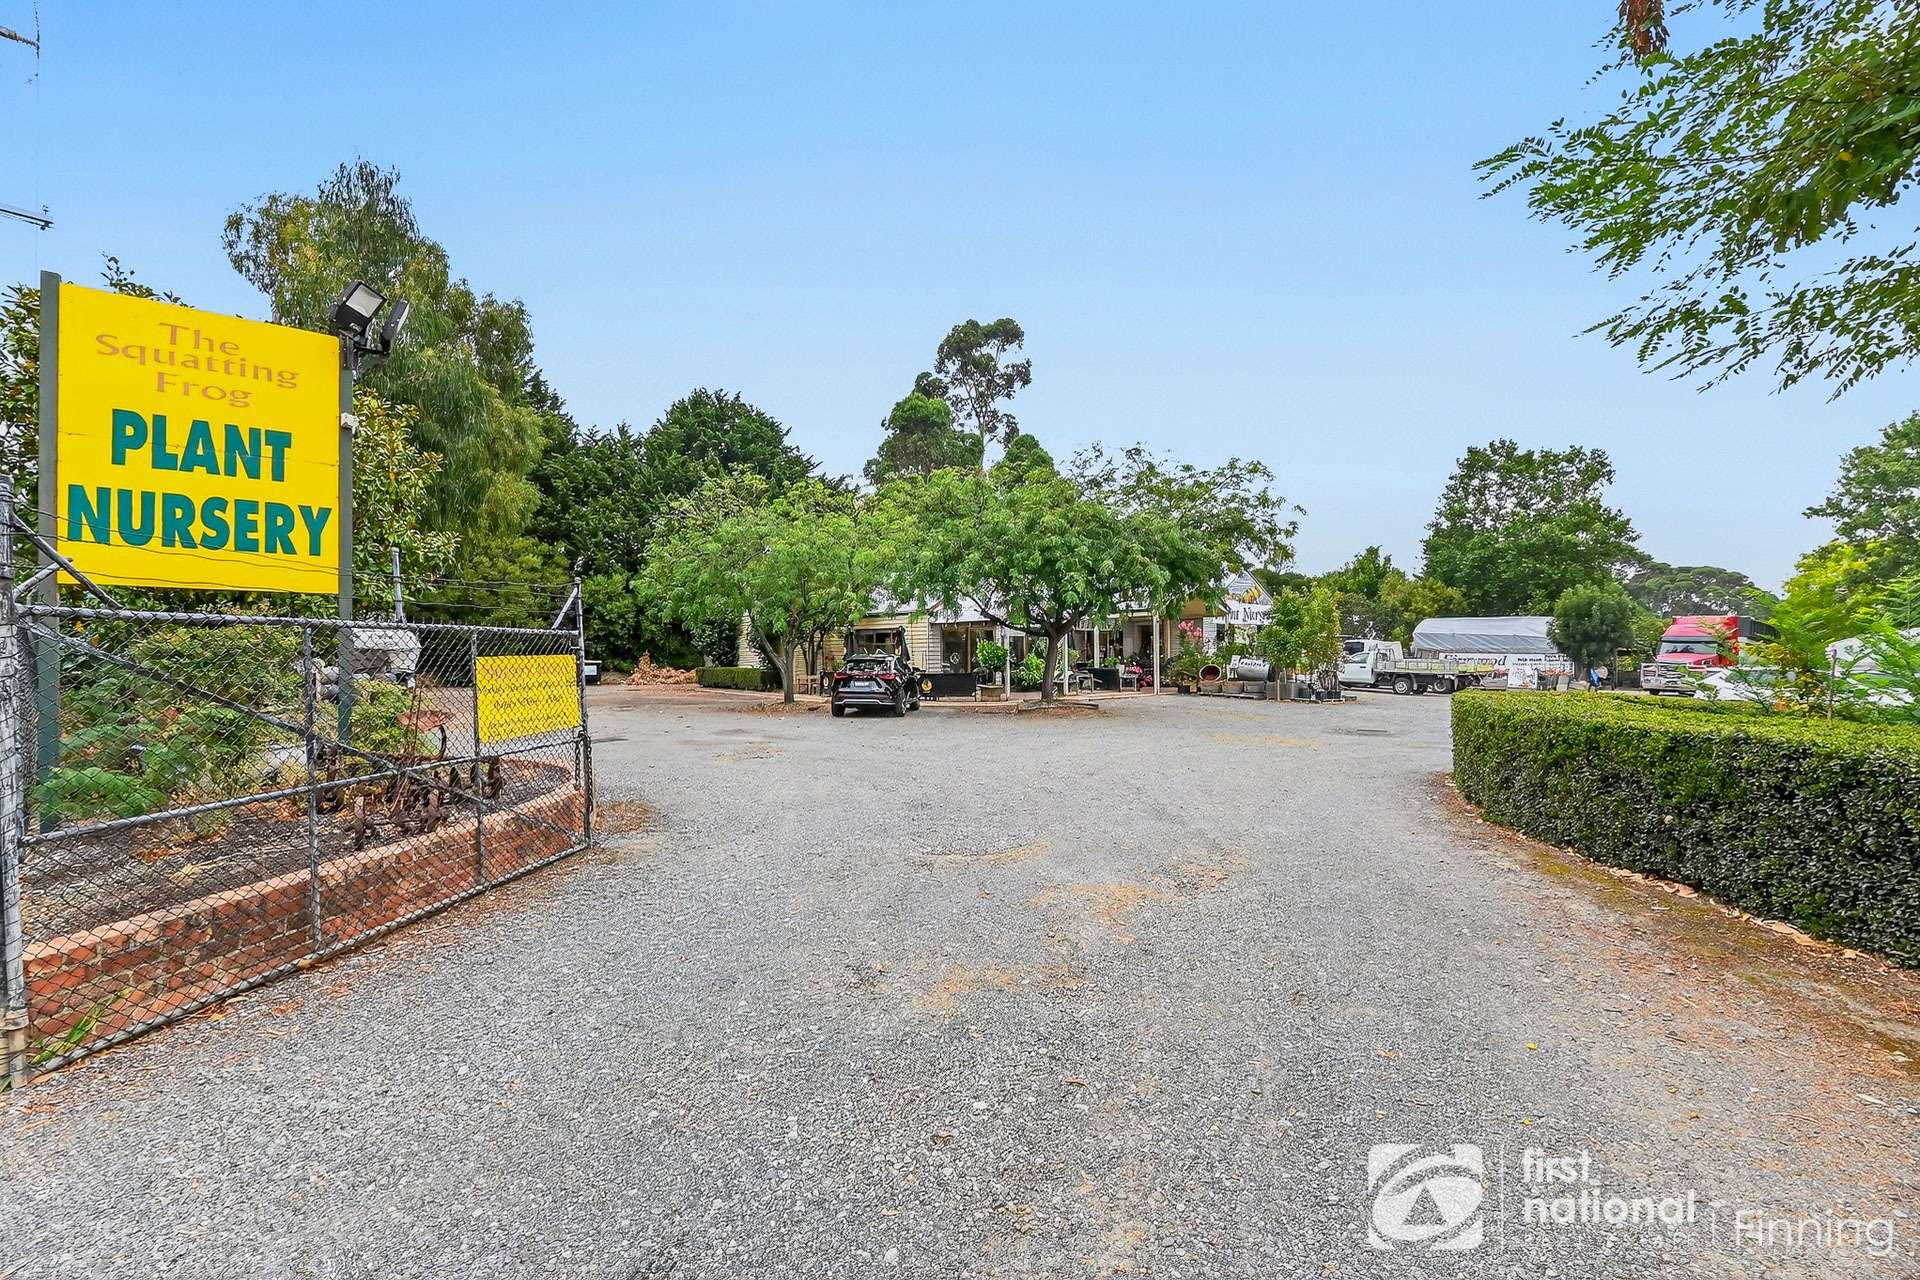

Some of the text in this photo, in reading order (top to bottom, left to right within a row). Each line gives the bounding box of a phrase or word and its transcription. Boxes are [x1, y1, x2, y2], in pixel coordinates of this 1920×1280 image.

[95, 334, 300, 389] Squatting
[158, 322, 240, 356] The
[156, 372, 253, 408] Frog
[111, 408, 293, 482] PLANT
[67, 484, 332, 557] NURSERY
